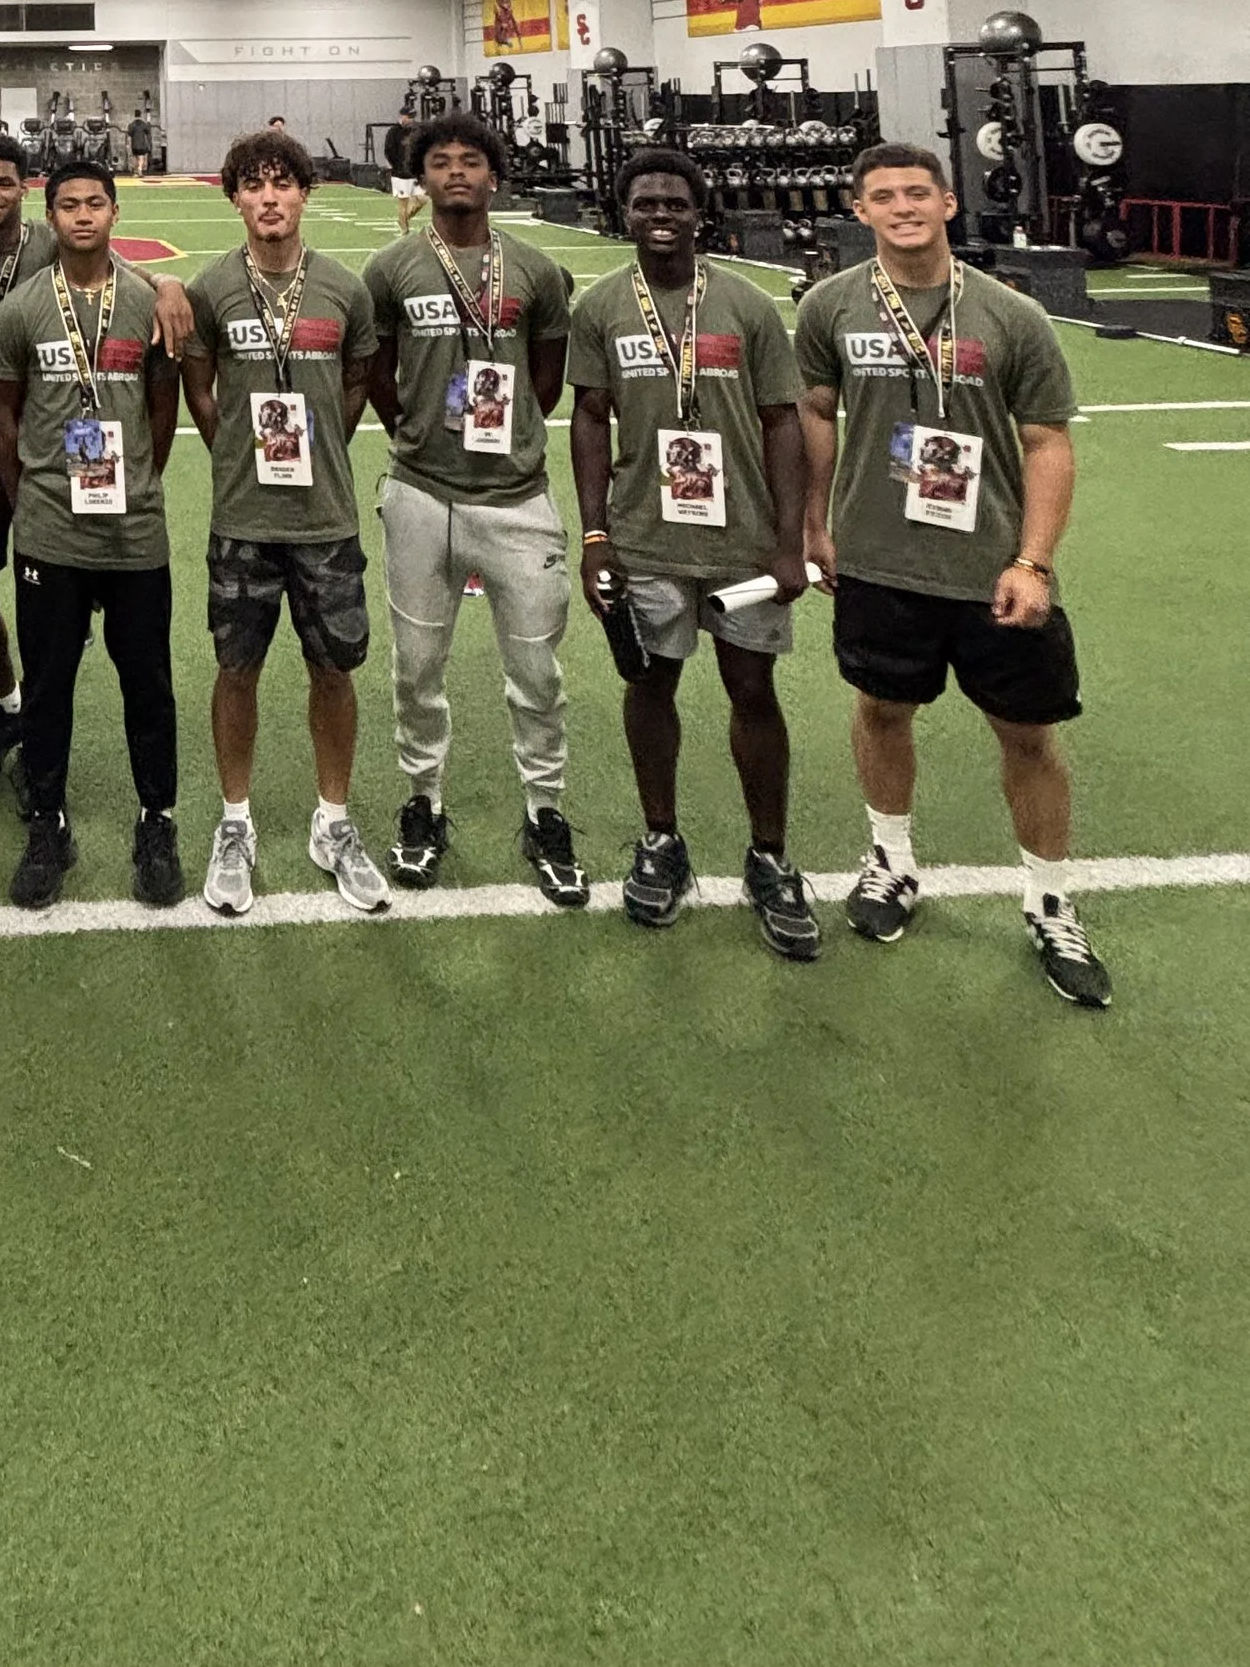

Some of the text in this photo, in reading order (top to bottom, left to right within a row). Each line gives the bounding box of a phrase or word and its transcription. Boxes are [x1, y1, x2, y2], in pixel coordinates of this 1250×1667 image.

[234, 45, 361, 57] FIGHT ON
[409, 300, 458, 321] USA
[233, 325, 271, 344] US
[412, 327, 517, 338] UNITED SPTS ROAD
[42, 347, 77, 367] US
[621, 342, 660, 361] US
[42, 372, 71, 382] UNITED
[107, 372, 139, 382] ABROAD
[622, 368, 656, 378] UNITED
[699, 368, 739, 378] ABROAD
